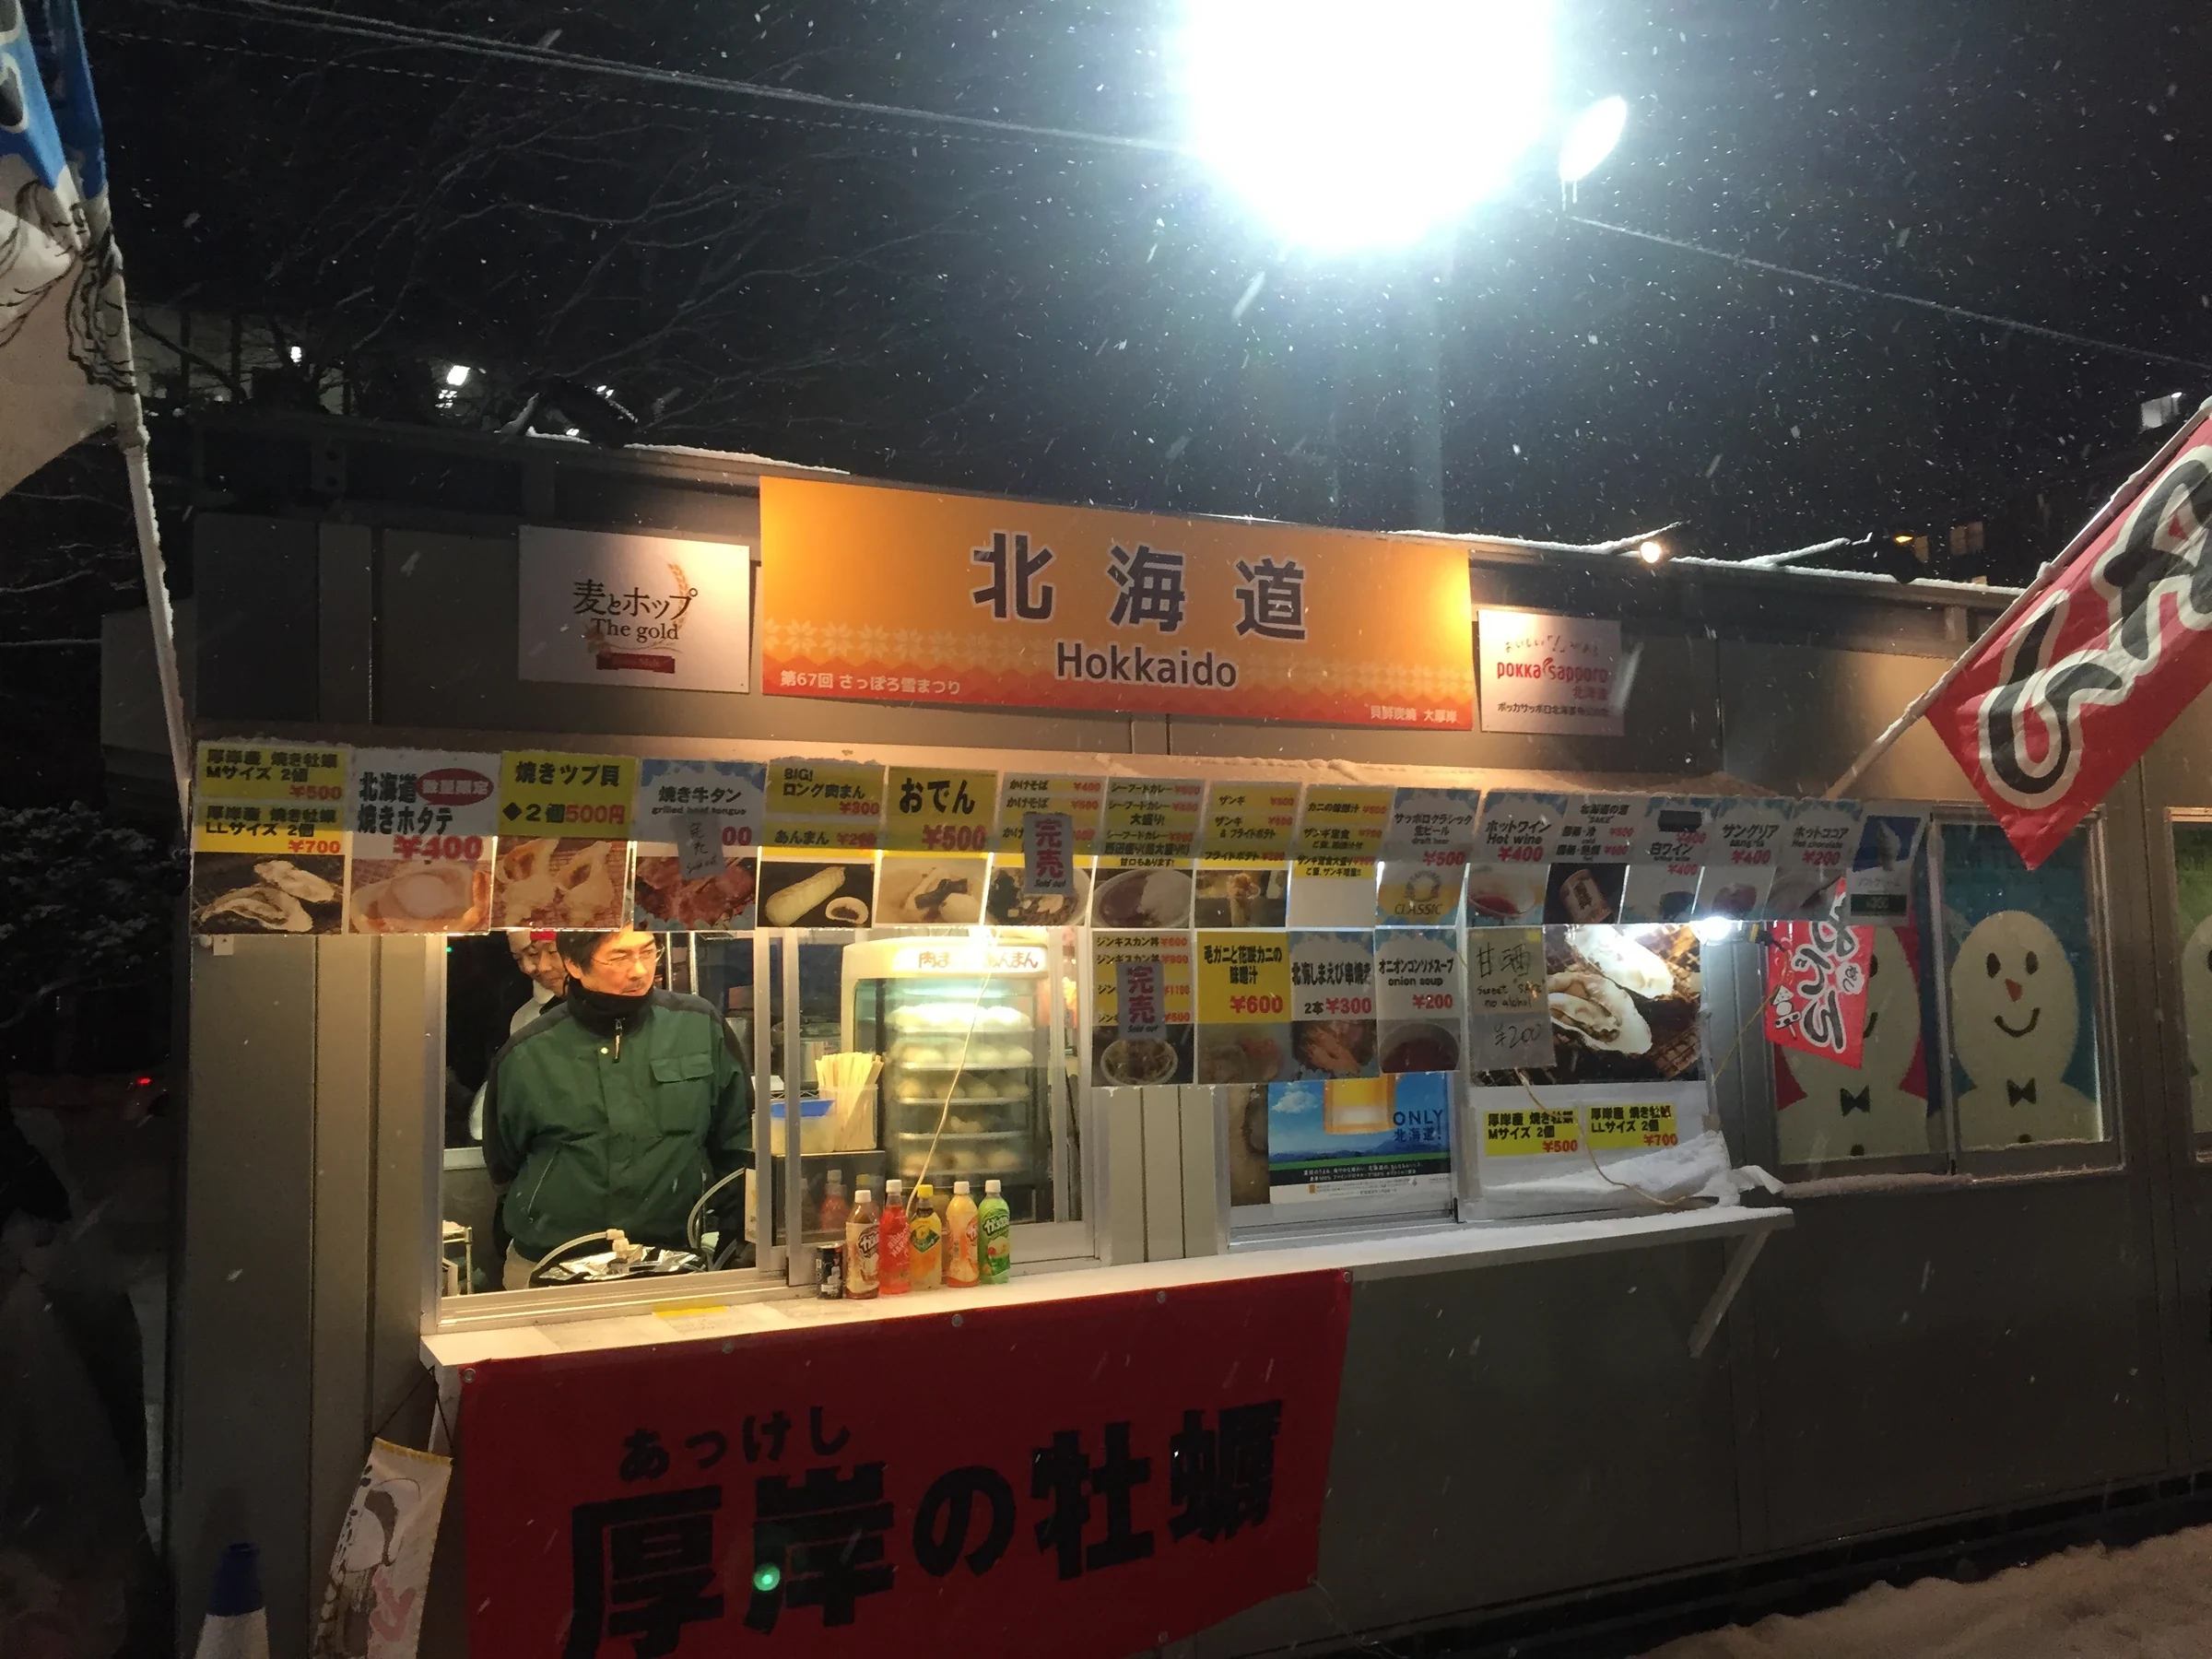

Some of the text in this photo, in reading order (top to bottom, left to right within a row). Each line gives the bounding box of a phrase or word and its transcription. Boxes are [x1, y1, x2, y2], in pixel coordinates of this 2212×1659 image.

[971, 531, 1307, 641] 北海道
[573, 579, 698, 620] 麦とホップ
[591, 618, 678, 643] The gold
[1055, 641, 1237, 690] Hokkaido
[780, 670, 960, 695] 第67回 さっぽろ雪まつり
[206, 766, 310, 782] Mサイズ 2個
[514, 760, 620, 788] 焼きツブ貝
[784, 768, 813, 782] BIG!
[289, 784, 343, 800] ¥500
[359, 771, 418, 804] 北海道
[783, 784, 865, 799] ロング肉まん
[1009, 780, 1049, 791] かけそば
[658, 785, 743, 804] 焼き牛タン
[900, 778, 976, 815] おでん
[1006, 797, 1050, 808] かけそば
[651, 806, 684, 816] grilled
[712, 806, 747, 817] tongue
[1394, 812, 1473, 826] サッポロクラシック
[357, 804, 453, 836] 焼きホタテ
[1486, 820, 1552, 833] ホットワイン
[206, 822, 314, 837] LLサイズ 2個
[722, 826, 753, 846] 00
[923, 824, 986, 851] ¥500
[1414, 826, 1450, 837] 生ビール
[1723, 823, 1780, 840] サングリア
[1794, 827, 1850, 840] ホットココア
[774, 830, 830, 846] あんまん
[1486, 833, 1543, 845] Hot wine
[288, 840, 341, 853] ¥700
[393, 835, 485, 861] ¥400
[1035, 818, 1064, 878] 完売
[1498, 846, 1544, 862] ¥400
[1651, 841, 1693, 855] 白ワイン
[1731, 849, 1771, 865] ¥400
[1394, 903, 1444, 915] CLASSIC
[919, 951, 950, 969] 肉ま
[1379, 958, 1454, 975] オニオンコンソメスープ
[1477, 941, 1533, 979] 甘酒
[1388, 977, 1443, 988] onion soup
[1127, 965, 1156, 1024] 完売
[1412, 993, 1453, 1010] ¥200
[1230, 994, 1284, 1014] ¥600
[1325, 997, 1371, 1015] ¥300
[1495, 1022, 1541, 1048] ¥200
[1394, 1110, 1443, 1125] ONLY
[1488, 1112, 1524, 1126] 厚岸産
[1591, 1107, 1625, 1121] 厚岸産
[1488, 1125, 1556, 1140] Mサイズ 2個
[1591, 1119, 1660, 1134] LLサイズ 2個
[1542, 1140, 1578, 1152] ¥500
[1643, 1134, 1678, 1147] ¥700
[618, 1404, 851, 1481] あっけし
[566, 1397, 1286, 1659] 厚岸の牡蠣
